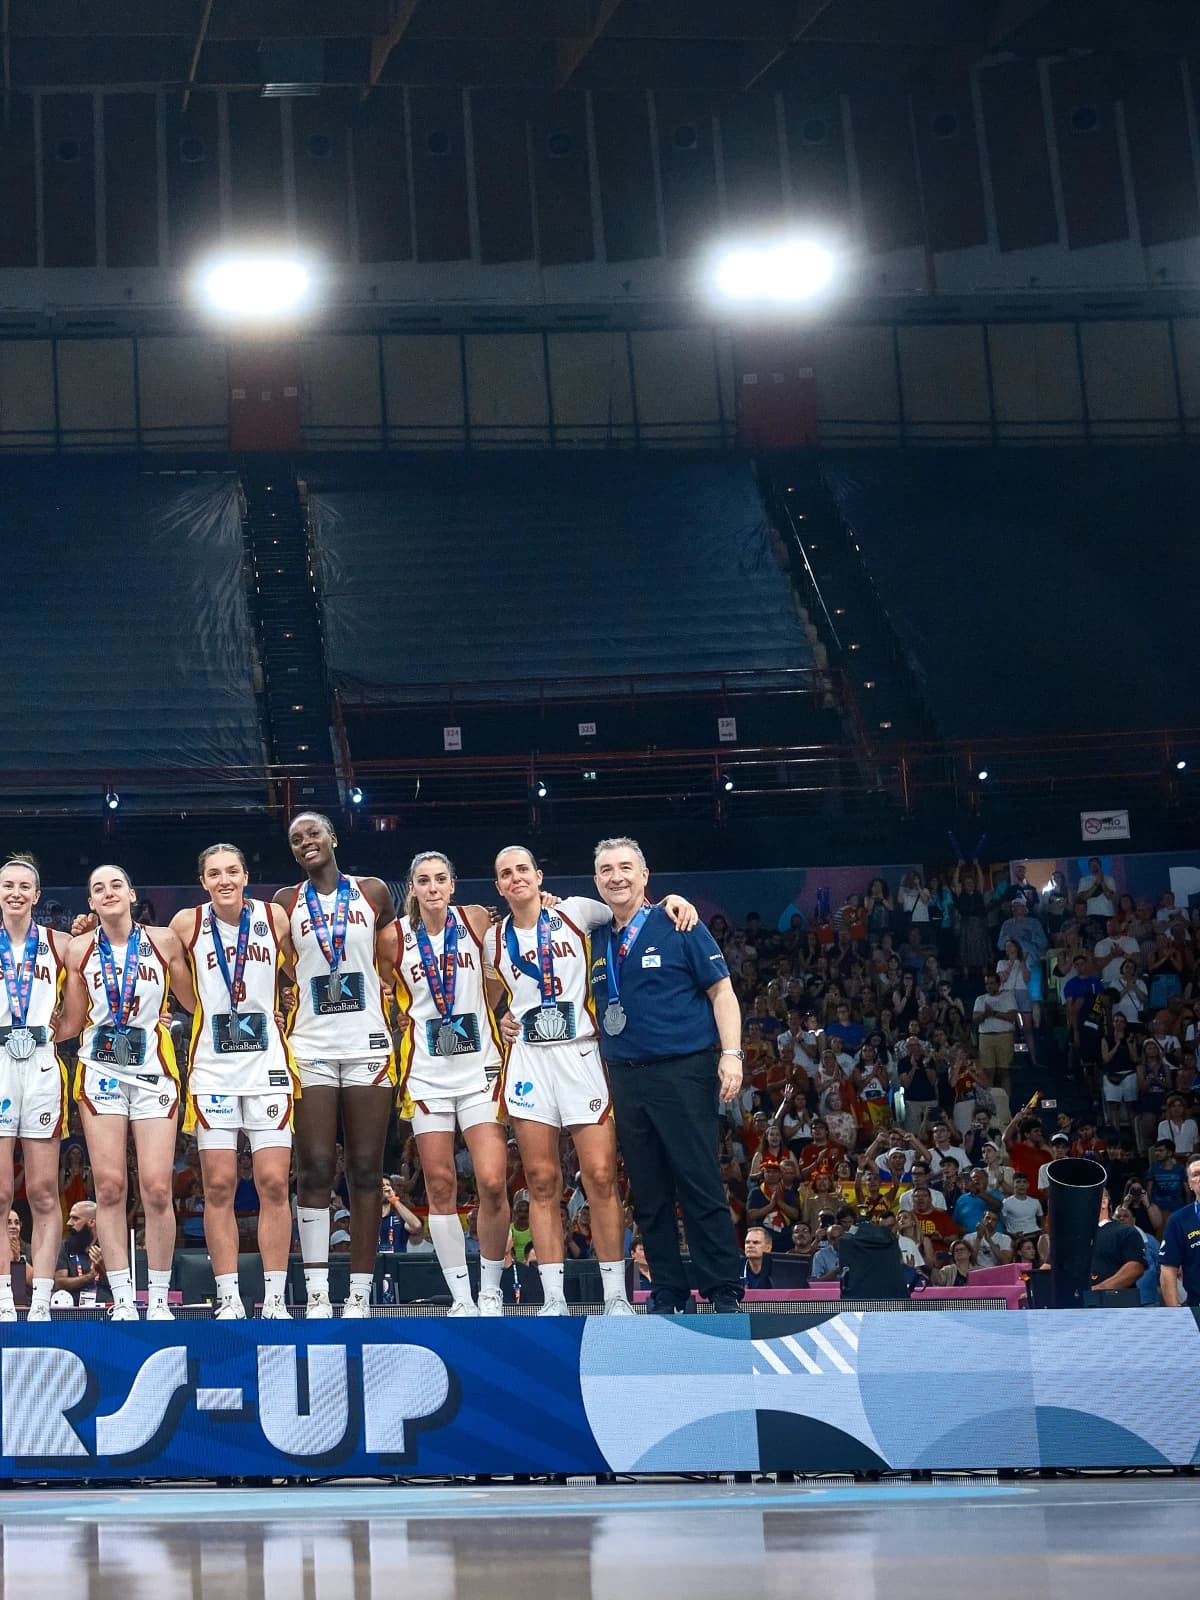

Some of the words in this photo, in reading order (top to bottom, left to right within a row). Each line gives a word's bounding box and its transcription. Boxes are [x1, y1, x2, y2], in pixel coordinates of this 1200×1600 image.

[541, 923, 550, 955] DREAM
[207, 942, 271, 970] EPÑA
[511, 940, 577, 981] EPÑA
[411, 952, 475, 983] EÑA
[543, 957, 550, 970] TO
[94, 962, 159, 990] EPÑA
[319, 1002, 360, 1014] CaixaBank
[528, 1031, 569, 1041] Caink
[221, 1041, 263, 1051] CaixaBank
[435, 1042, 475, 1055] CBank
[96, 1051, 138, 1065] Caixnk
